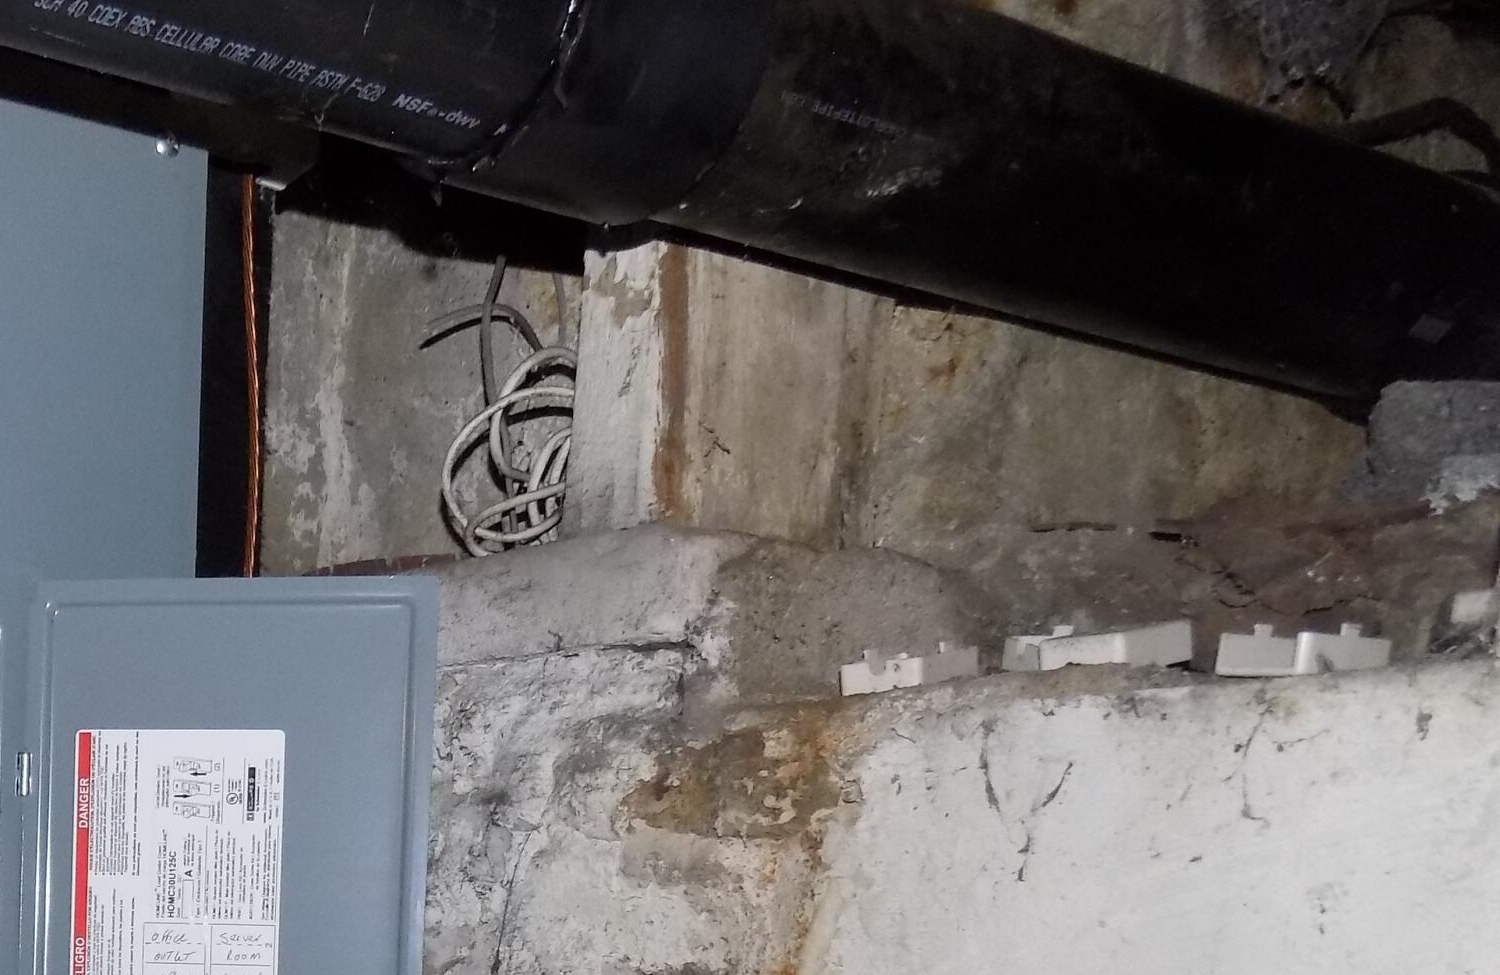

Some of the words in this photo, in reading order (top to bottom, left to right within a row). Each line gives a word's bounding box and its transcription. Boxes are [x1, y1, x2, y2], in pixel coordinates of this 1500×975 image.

[68, 0, 86, 18] 40
[88, 3, 126, 29] COEX
[128, 14, 156, 38] ABS
[154, 22, 221, 55] CELLULAR
[220, 40, 256, 64] CORE
[282, 59, 312, 82] PIPE
[310, 66, 347, 91] ASTM
[79, 777, 89, 829] DANGER
[167, 851, 177, 918] HOMC30U125C
[184, 870, 193, 878] A
